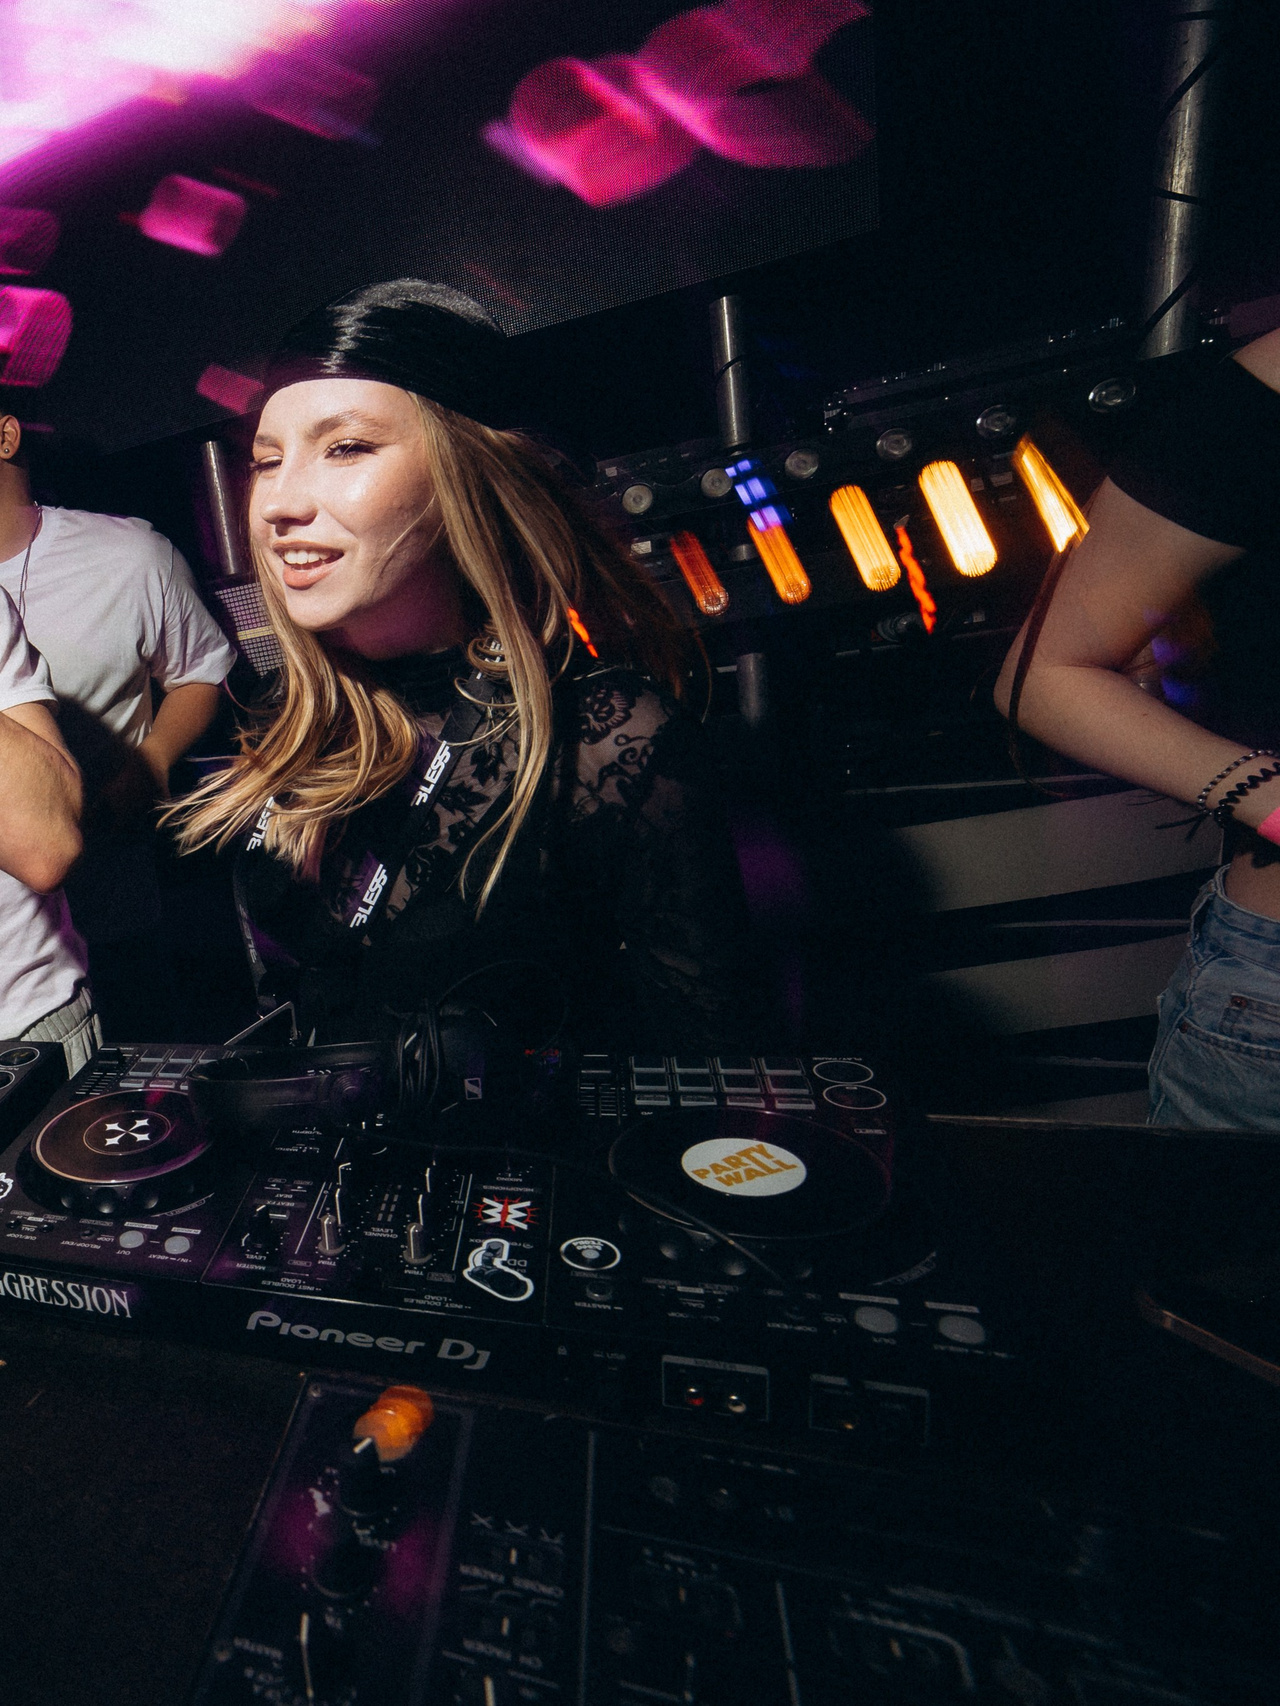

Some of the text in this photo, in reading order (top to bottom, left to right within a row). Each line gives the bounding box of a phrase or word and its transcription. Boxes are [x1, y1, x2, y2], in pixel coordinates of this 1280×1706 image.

[410, 740, 451, 806] BLESS
[349, 863, 389, 928] BLESS
[690, 1143, 775, 1179] PARTY
[715, 1159, 798, 1187] WALL
[246, 1310, 491, 1371] Pioneer DJ
